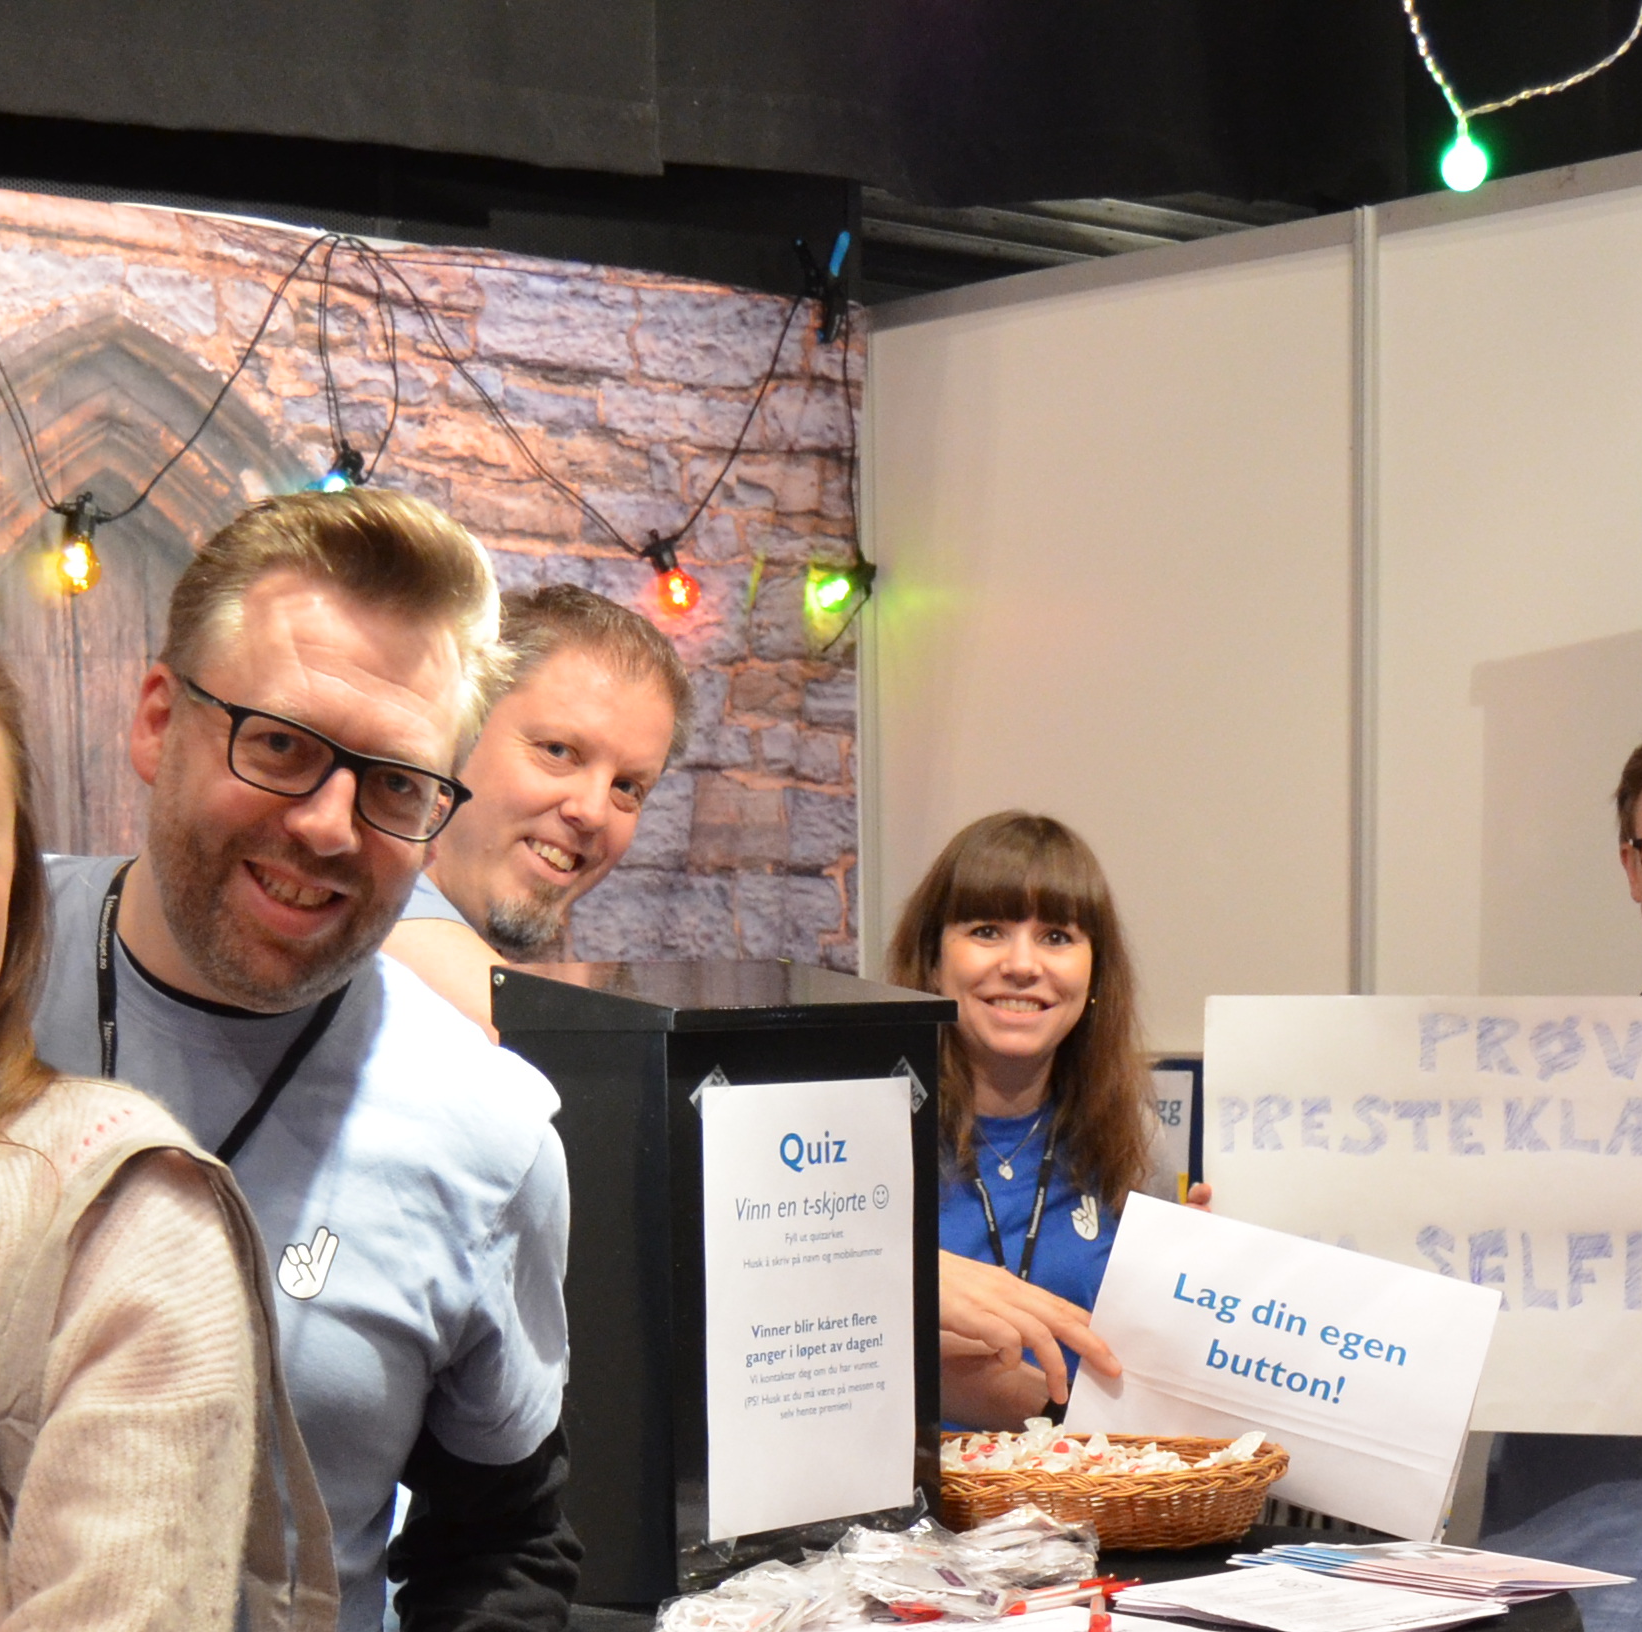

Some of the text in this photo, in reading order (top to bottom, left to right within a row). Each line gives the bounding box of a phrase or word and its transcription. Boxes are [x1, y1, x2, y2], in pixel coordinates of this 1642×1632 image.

[780, 1130, 847, 1173] Quiz
[736, 1191, 867, 1221] Vinn en t-skjorte
[743, 1258, 763, 1269] Husk
[772, 1256, 789, 1267] skriv
[792, 1254, 800, 1267] på
[822, 1252, 831, 1264] og
[751, 1313, 878, 1339] Vinner blir kåret flere
[1173, 1272, 1407, 1367] Lag din egen
[745, 1333, 883, 1368] ganger i løpet av dagen!
[798, 1368, 812, 1380] deg
[828, 1364, 837, 1375] du
[839, 1363, 851, 1373] har
[1206, 1338, 1346, 1404] button!
[792, 1390, 802, 1401] du
[876, 1380, 885, 1391] og
